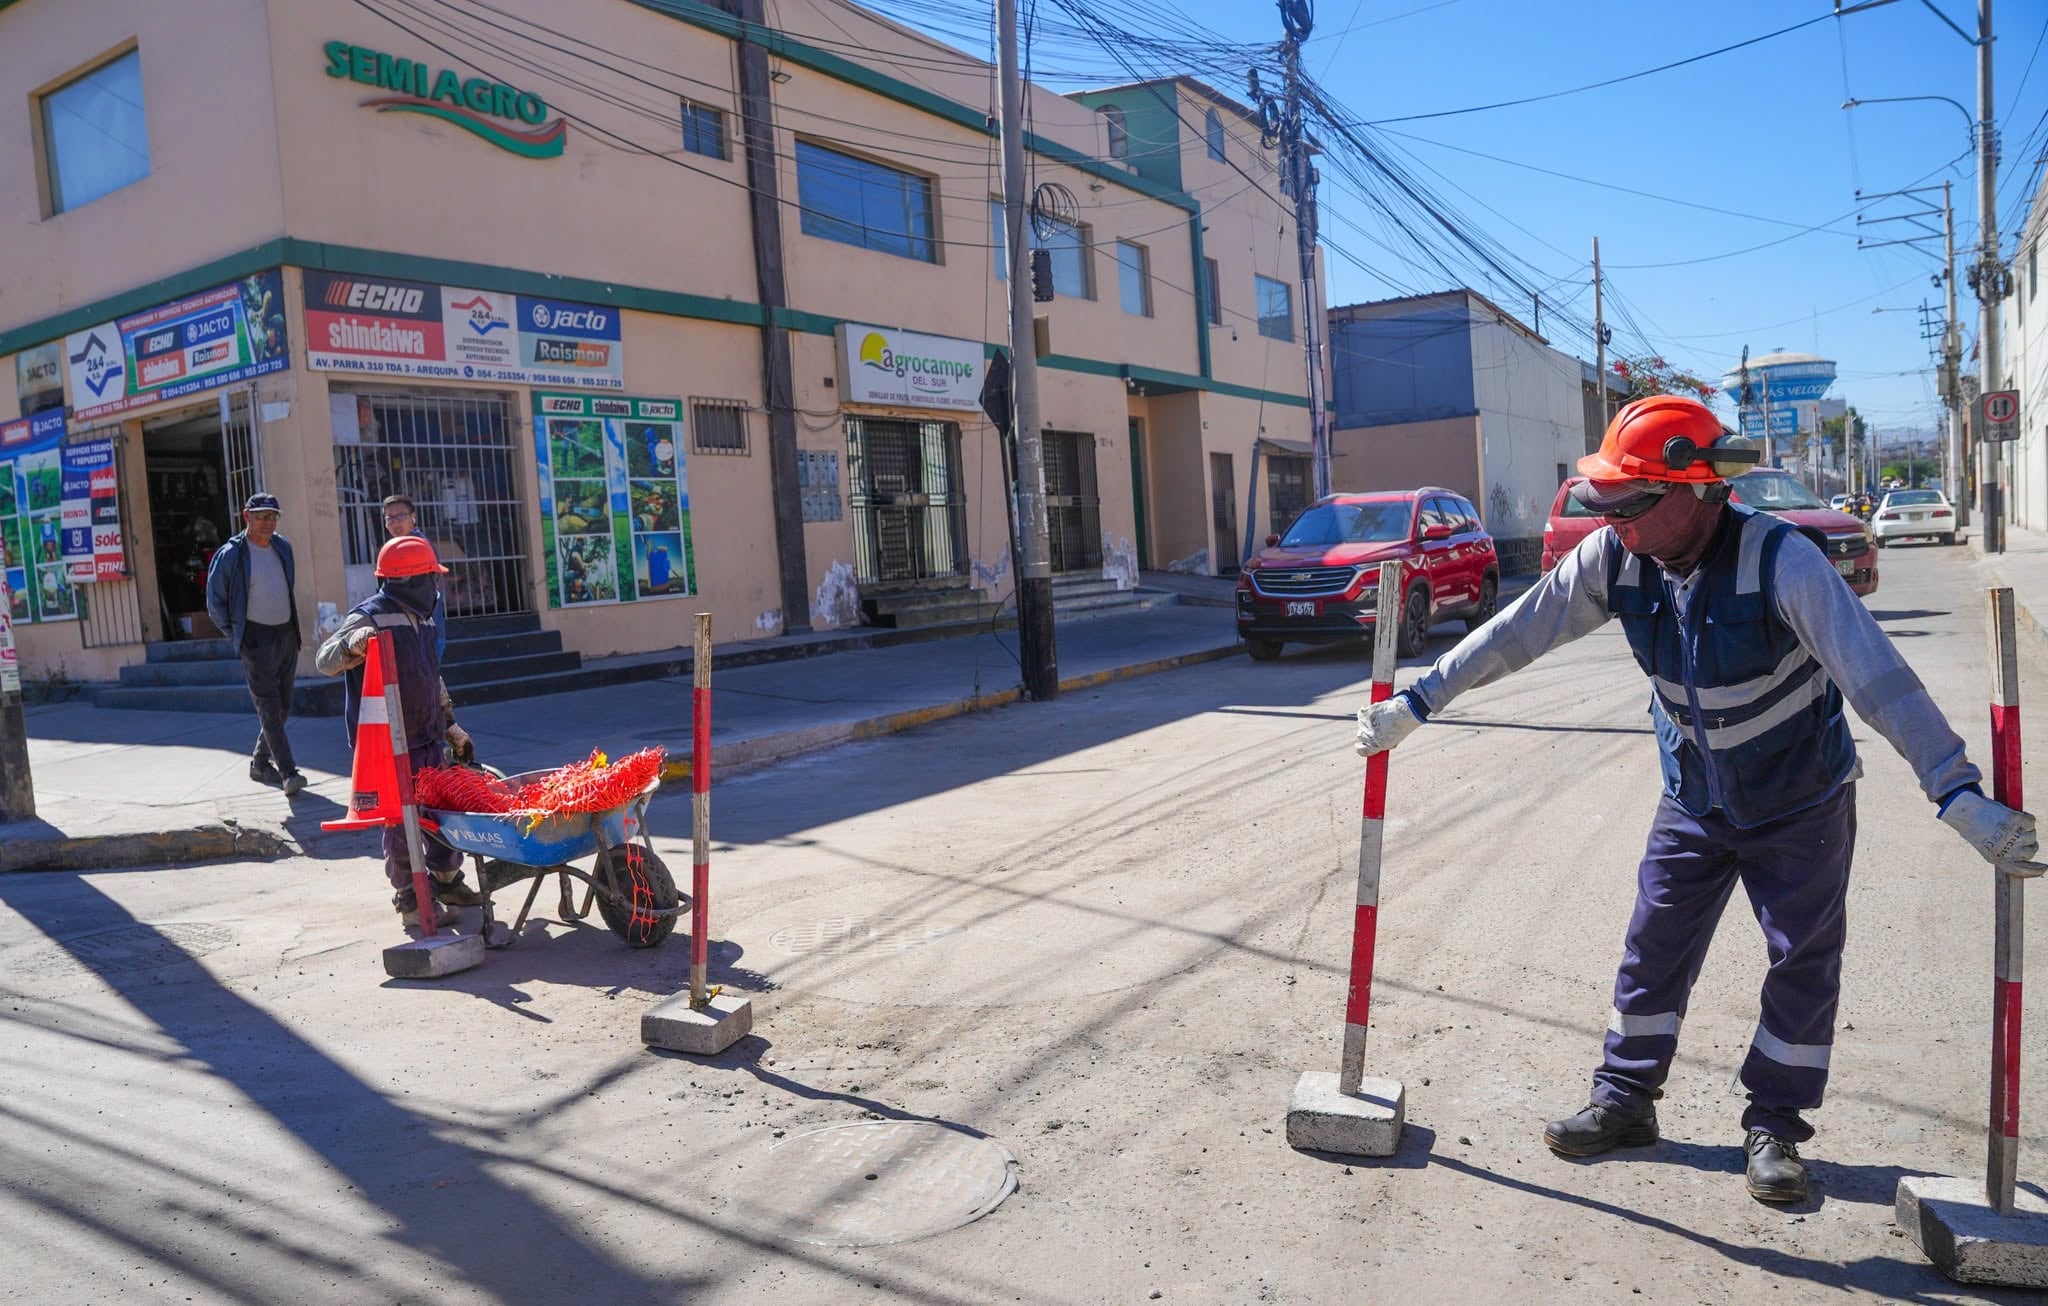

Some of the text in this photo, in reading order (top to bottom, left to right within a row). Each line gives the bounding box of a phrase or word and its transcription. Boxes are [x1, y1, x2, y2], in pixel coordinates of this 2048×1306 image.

[347, 282, 424, 314] ECHO
[471, 309, 490, 320] 2&4
[197, 316, 230, 337] JACTO
[149, 331, 174, 351] ECHO
[328, 318, 425, 355] shindaiwa
[194, 345, 228, 364] Raisman
[456, 344, 484, 353] SERVICIO
[539, 341, 606, 364] Raisman
[86, 356, 105, 372] 2&4
[465, 353, 504, 362] AUTORIZADO
[26, 361, 57, 383] JACTO
[143, 357, 180, 383] shindaiwa
[257, 363, 270, 374] 237
[315, 358, 331, 369] AV.
[333, 359, 366, 371] PARRA
[367, 361, 384, 371] 310
[385, 362, 404, 373] TDA
[404, 363, 411, 373] 3
[416, 365, 459, 377] AREQUIPA
[609, 379, 623, 389] 725
[912, 376, 948, 388] DEL SUR
[889, 392, 896, 401] DE
[552, 399, 582, 411] ECHO
[594, 400, 630, 415] shindaiwa
[40, 416, 62, 433] JACTO
[77, 453, 108, 466] REPUESTOS
[70, 480, 89, 491] JACTO
[63, 509, 89, 520] HONDA
[97, 561, 126, 574] STIHL
[459, 829, 504, 844] VELKAS
